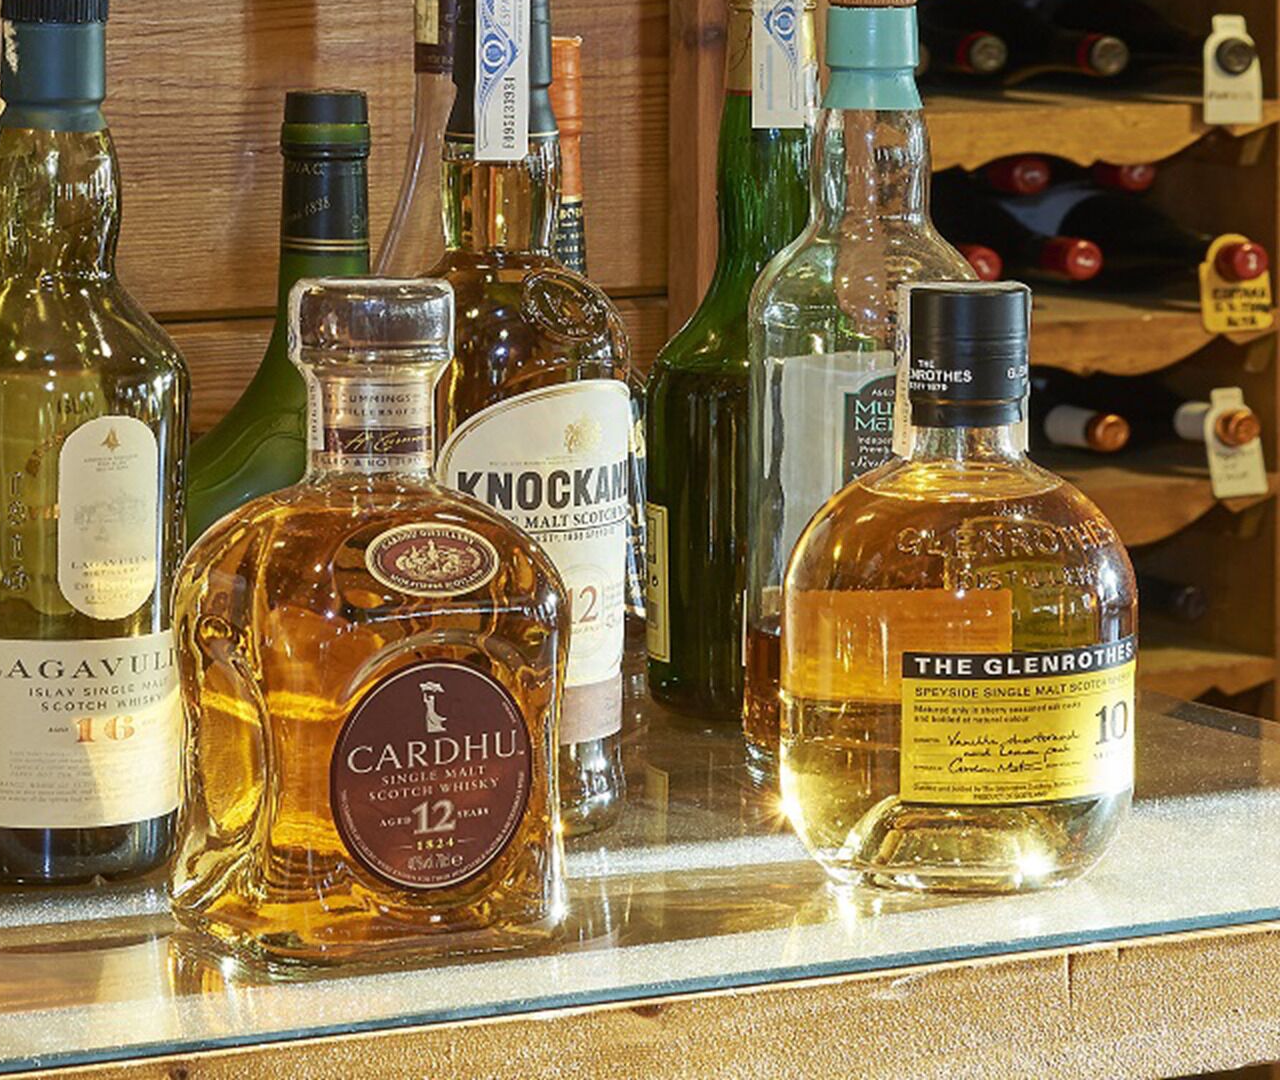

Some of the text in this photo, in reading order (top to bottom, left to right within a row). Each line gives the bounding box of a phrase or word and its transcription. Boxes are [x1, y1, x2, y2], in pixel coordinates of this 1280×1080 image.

[524, 513, 570, 530] MALT
[913, 642, 1134, 677] THE GLENROTHES
[28, 687, 77, 698] ISLAY
[83, 682, 136, 697] SINGLE
[914, 686, 978, 699] SPEYSIDE
[982, 685, 1032, 698] SINGLE
[1035, 683, 1066, 695] MALT
[40, 701, 109, 712] SCOTCH
[76, 715, 137, 744] 16
[1095, 700, 1128, 745] 10
[347, 729, 518, 774] CARDHU
[380, 765, 487, 786] SINGLE MALT
[368, 777, 501, 802] SCOTCH WHISKY
[378, 816, 412, 829] AGED
[411, 799, 458, 835] 12
[415, 836, 456, 851] 1824
